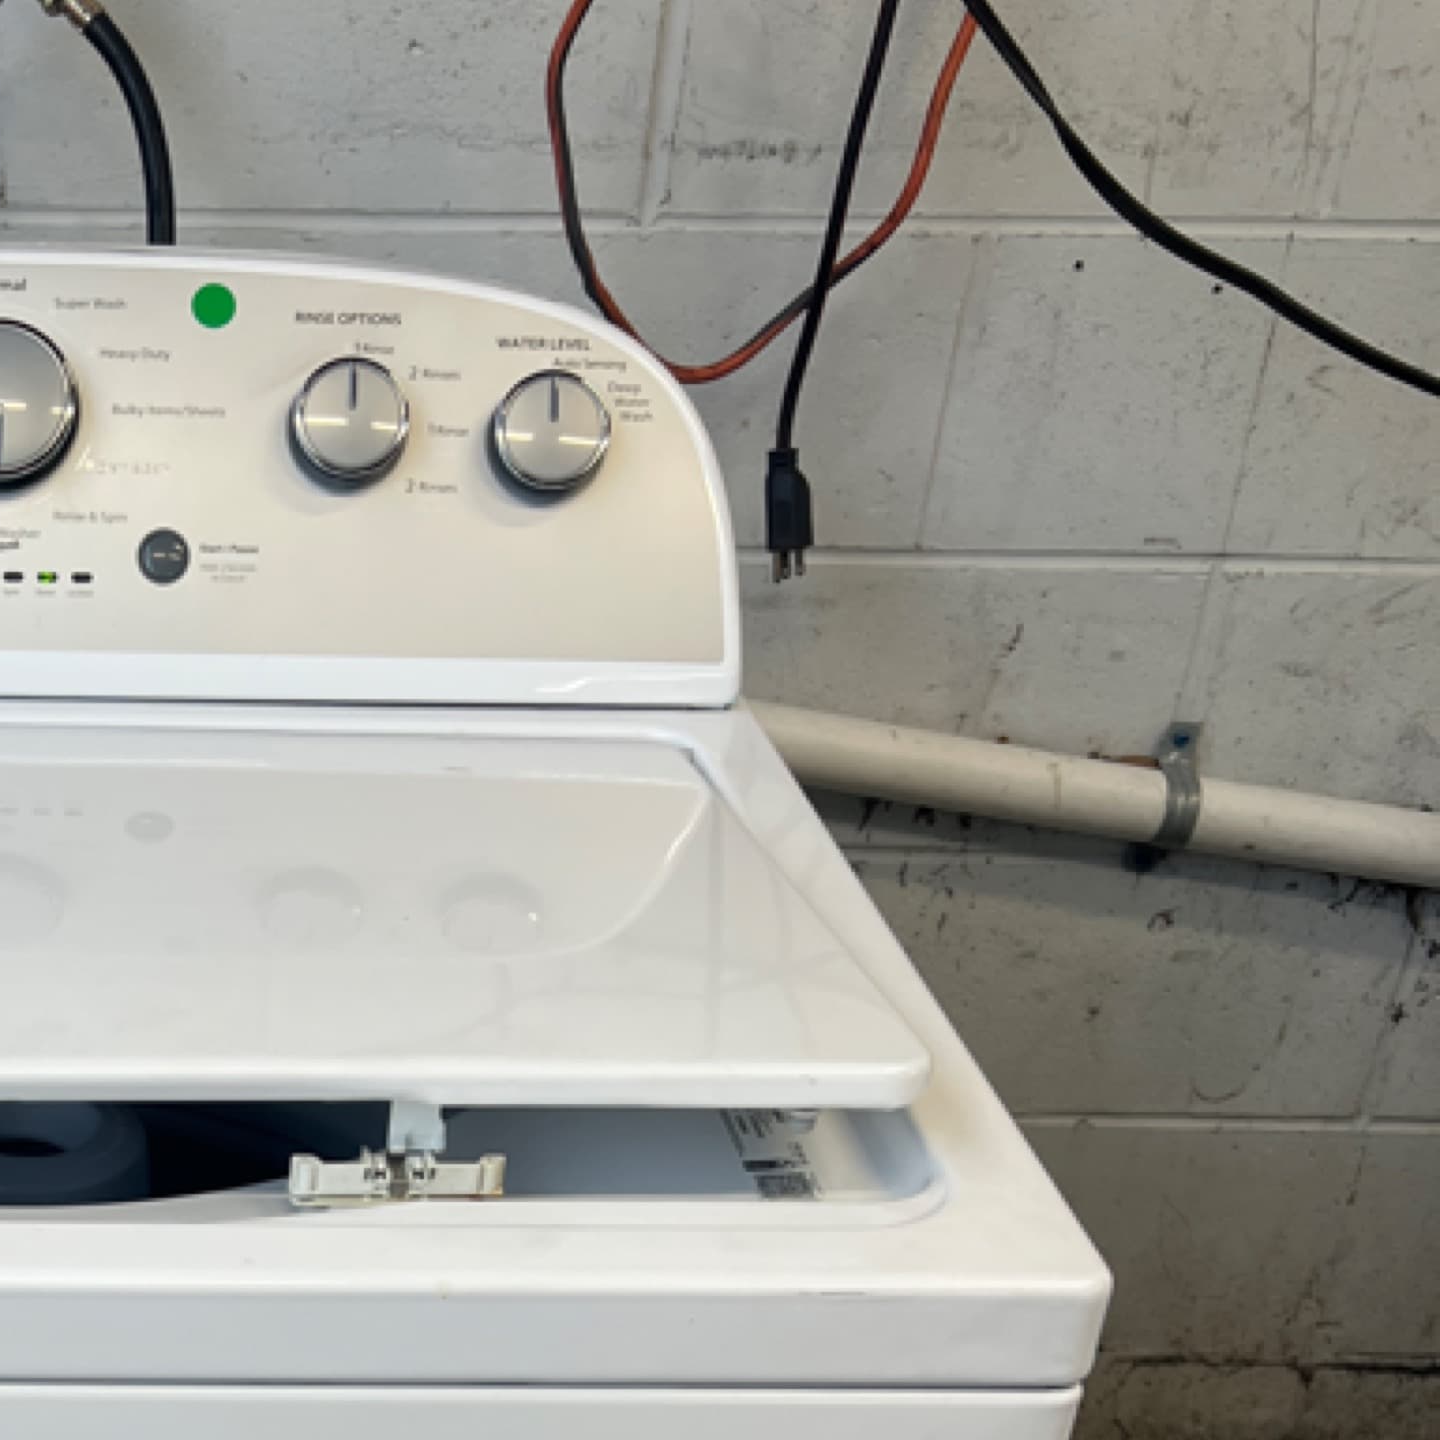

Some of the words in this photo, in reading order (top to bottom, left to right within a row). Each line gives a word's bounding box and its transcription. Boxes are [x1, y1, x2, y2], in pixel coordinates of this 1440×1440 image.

[295, 311, 335, 325] RINSE
[338, 311, 402, 325] OPTIONS
[495, 335, 548, 350] WATER
[551, 336, 591, 351] LEVEL
